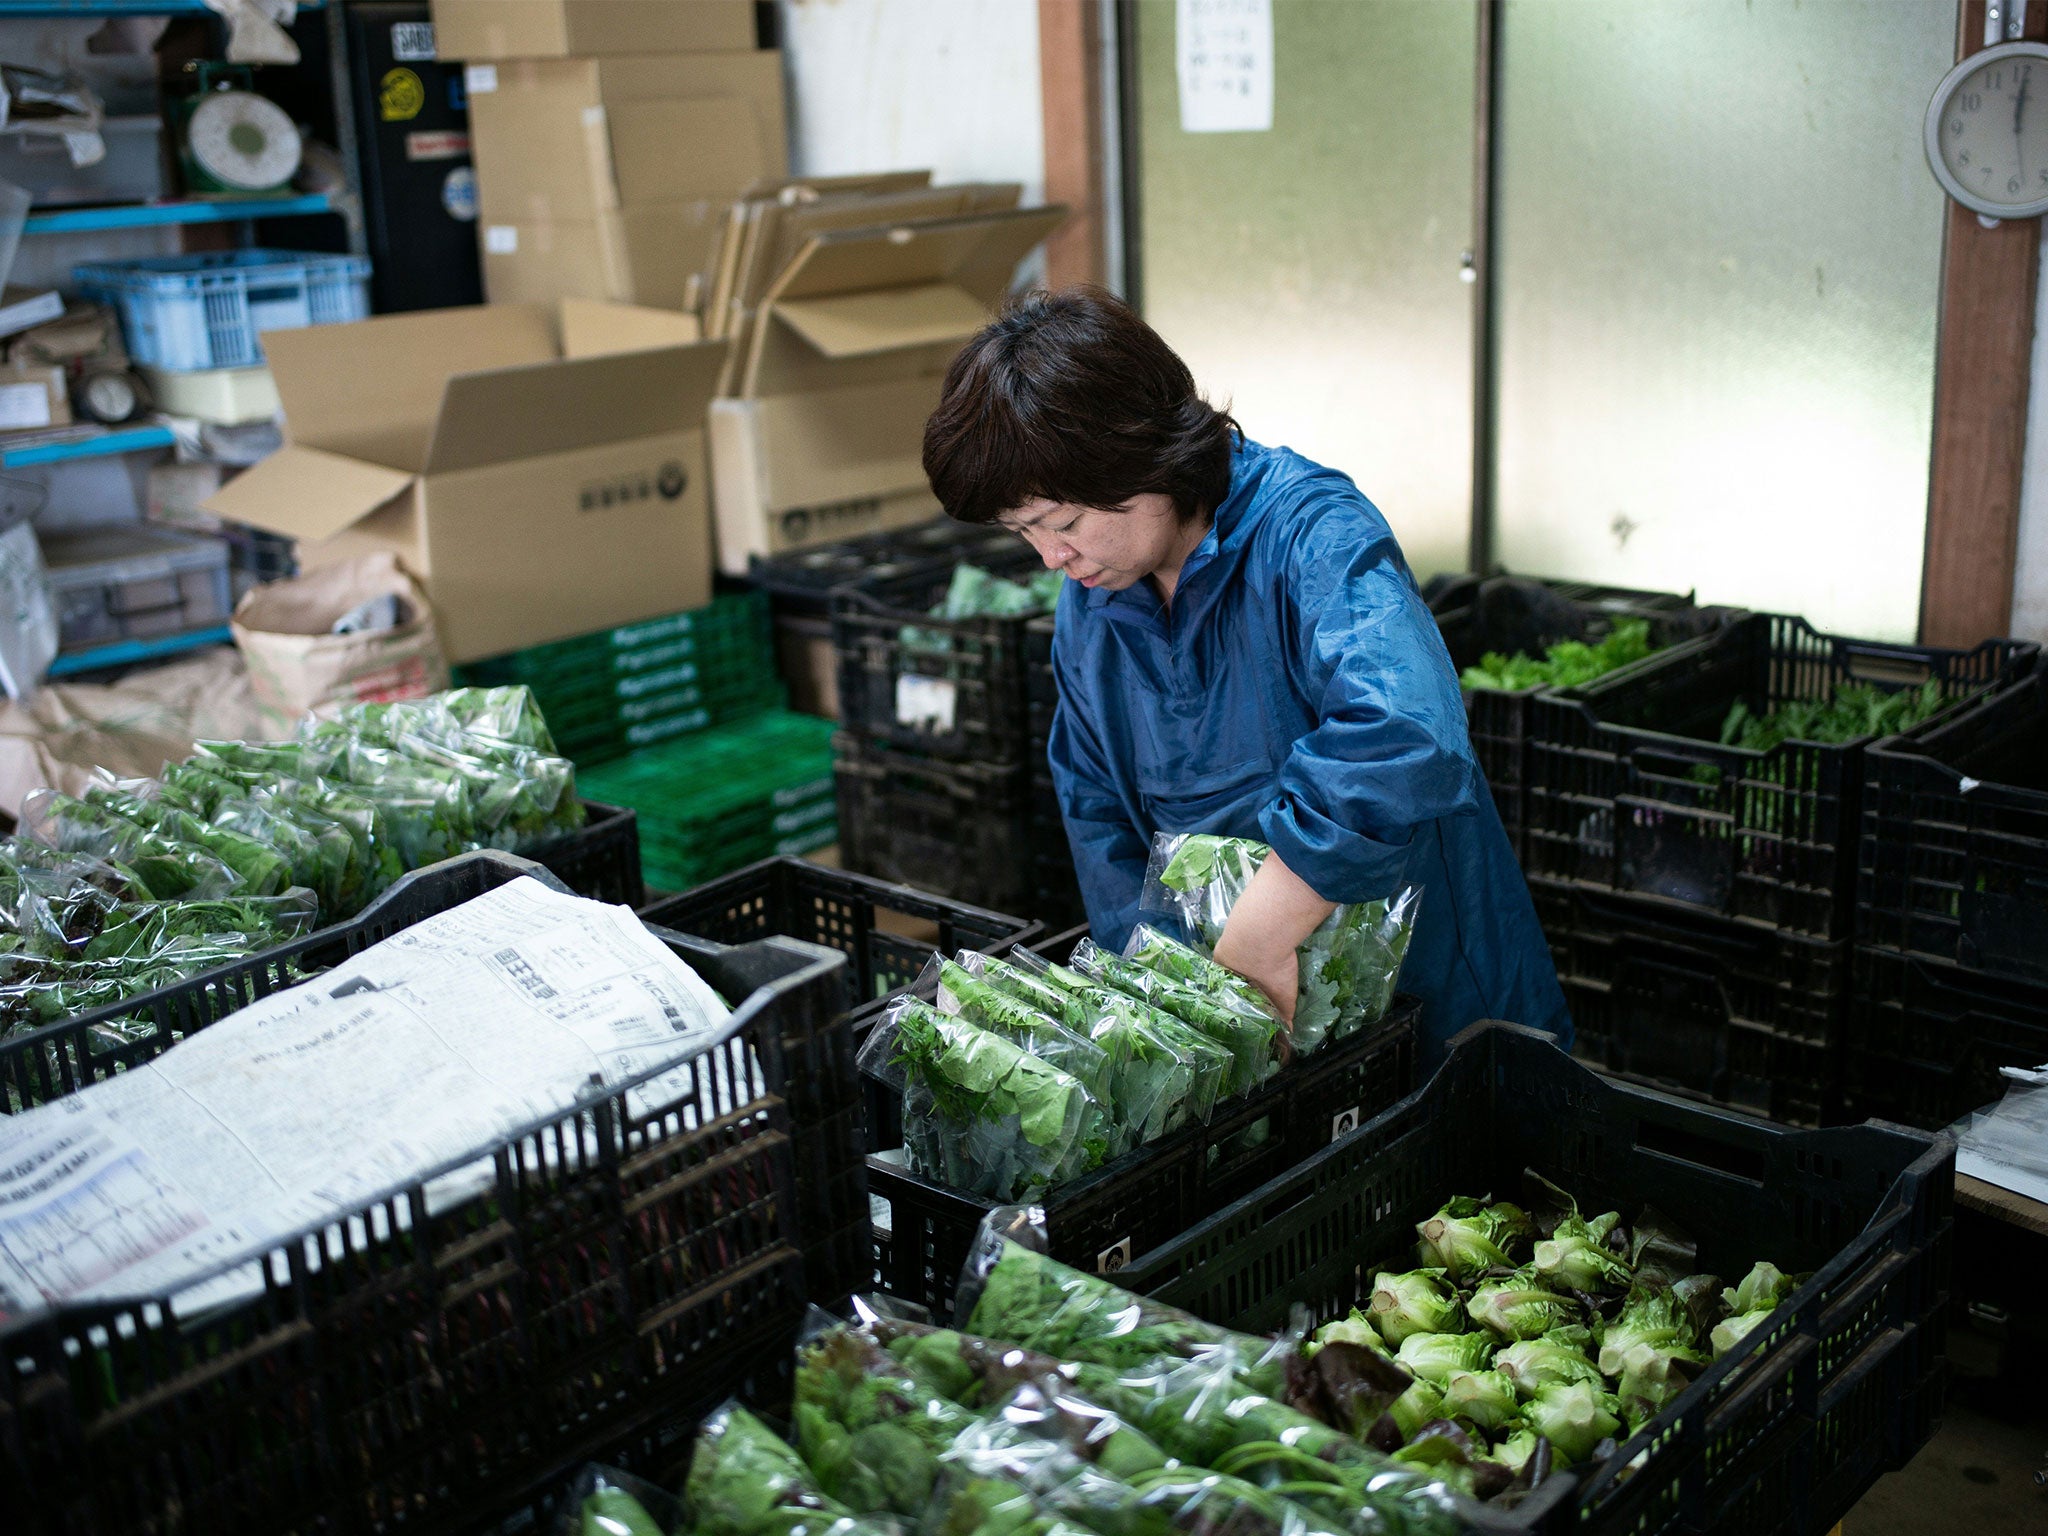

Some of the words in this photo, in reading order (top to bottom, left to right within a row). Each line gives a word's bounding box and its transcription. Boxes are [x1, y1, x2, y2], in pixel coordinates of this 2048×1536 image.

[1985, 70, 2001, 90] 11
[2014, 63, 2032, 82] 12
[1961, 93, 1981, 113] 10
[1951, 119, 1963, 137] 9
[1959, 149, 1970, 168] 8
[1981, 166, 1993, 185] 7
[2007, 175, 2019, 194] 6
